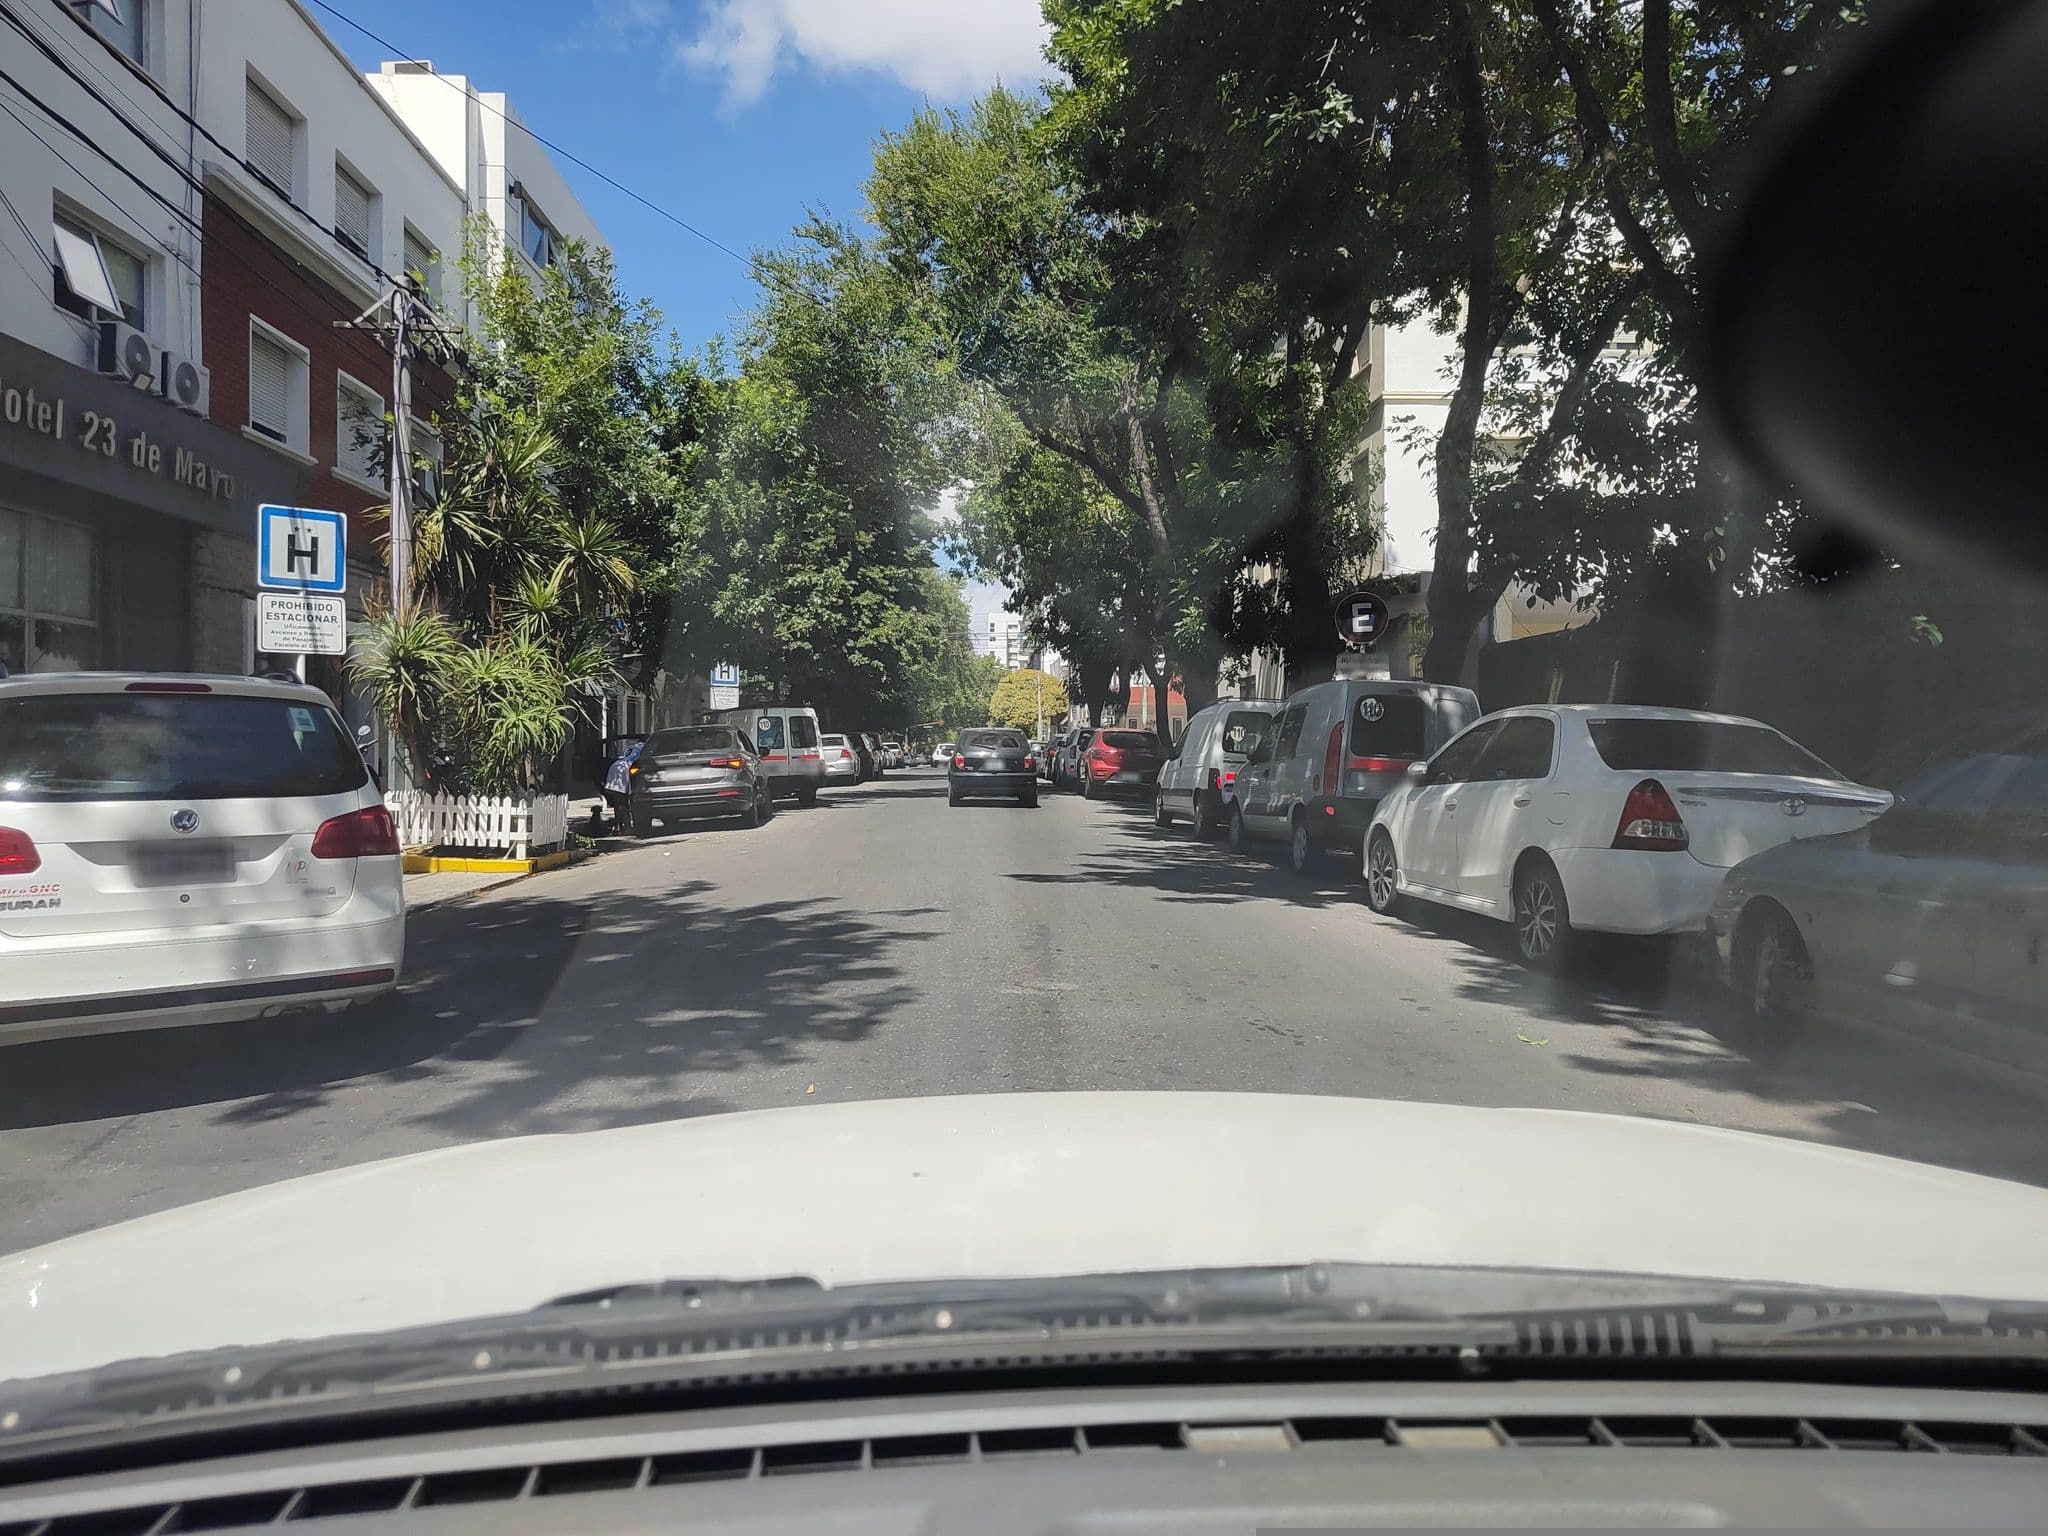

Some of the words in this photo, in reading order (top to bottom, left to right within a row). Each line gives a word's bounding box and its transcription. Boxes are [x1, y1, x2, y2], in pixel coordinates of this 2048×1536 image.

[0, 378, 64, 440] otel
[82, 411, 117, 457] 23
[132, 431, 161, 473] de
[287, 534, 319, 575] H
[266, 611, 338, 623] ESTACIONAR
[270, 600, 333, 612] PROHIBIDO
[1351, 602, 1374, 633] E
